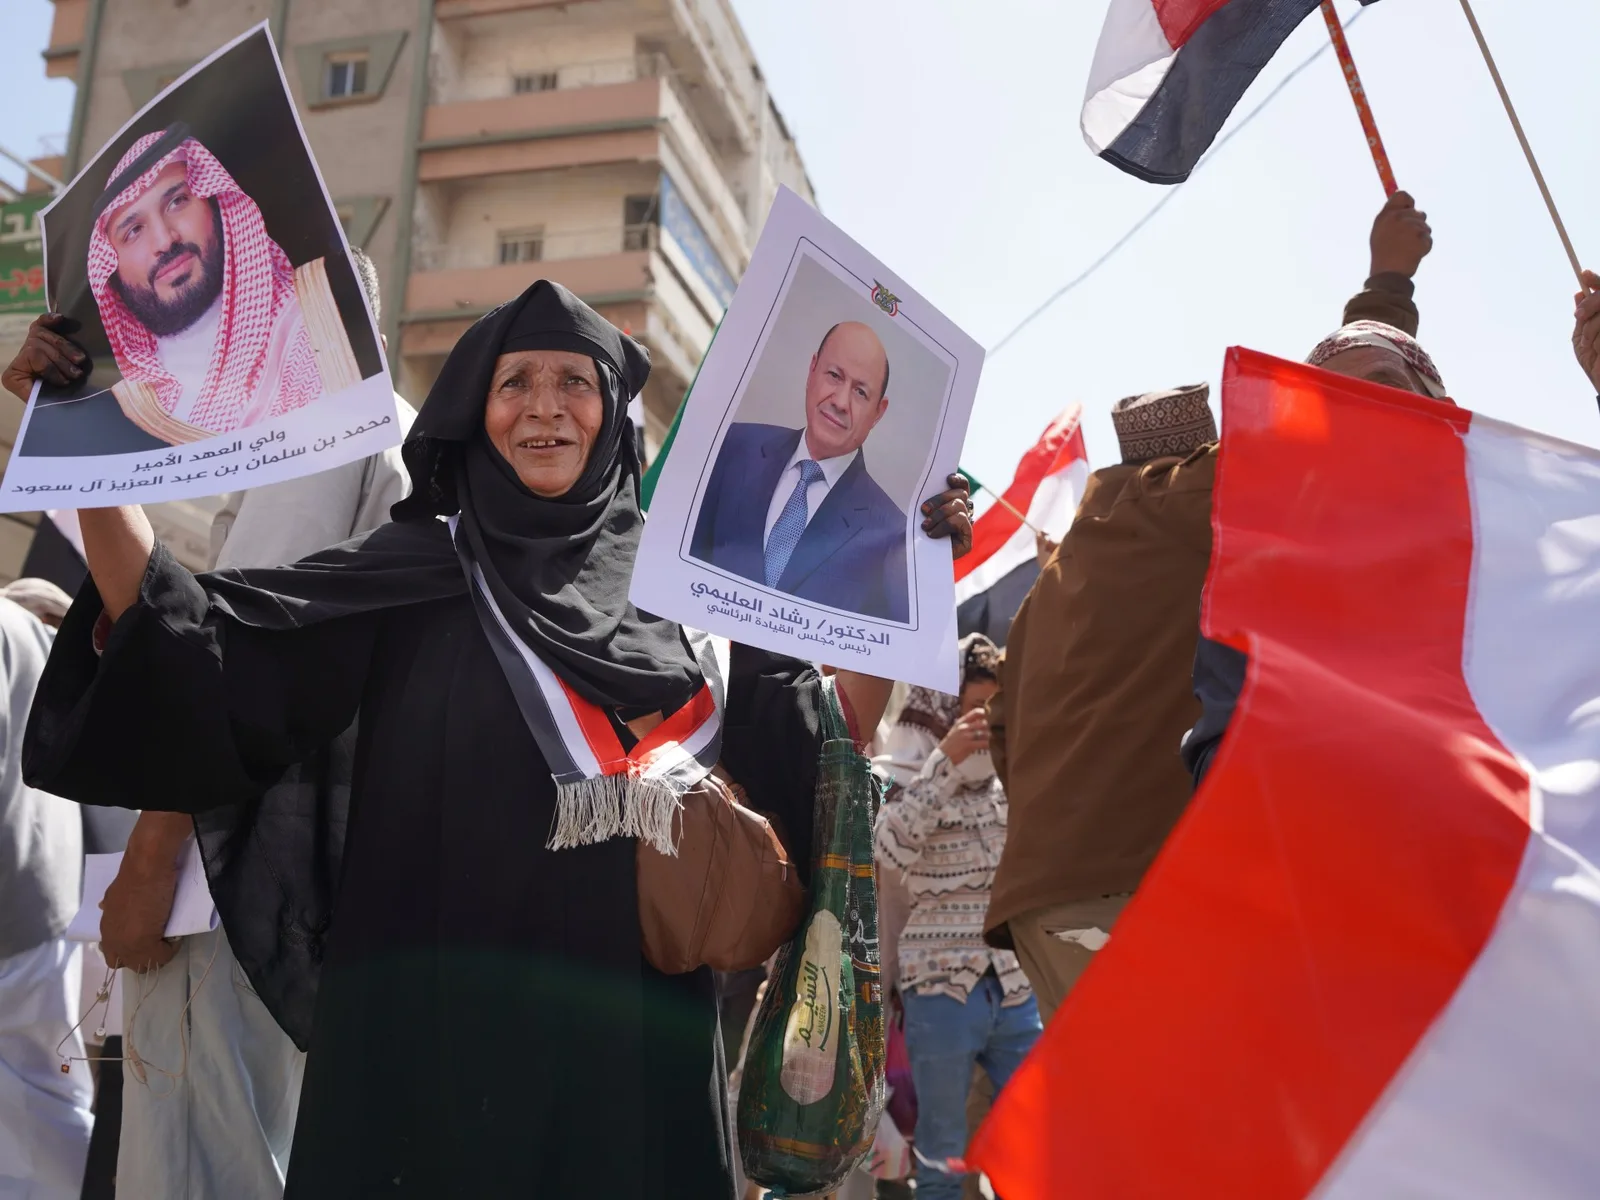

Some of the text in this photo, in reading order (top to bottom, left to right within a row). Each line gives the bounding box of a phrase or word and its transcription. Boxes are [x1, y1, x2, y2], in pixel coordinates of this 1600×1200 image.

[12, 414, 391, 495] محمد بن سلمان بن عبد العزيز آل سعود
[132, 428, 286, 473] ولي العهد الأمير
[690, 580, 762, 613] العليمي
[768, 606, 810, 630] رشاد
[706, 602, 872, 656] رئيس مجلس القيادة الرئاسي
[799, 960, 818, 1048] النسيم
